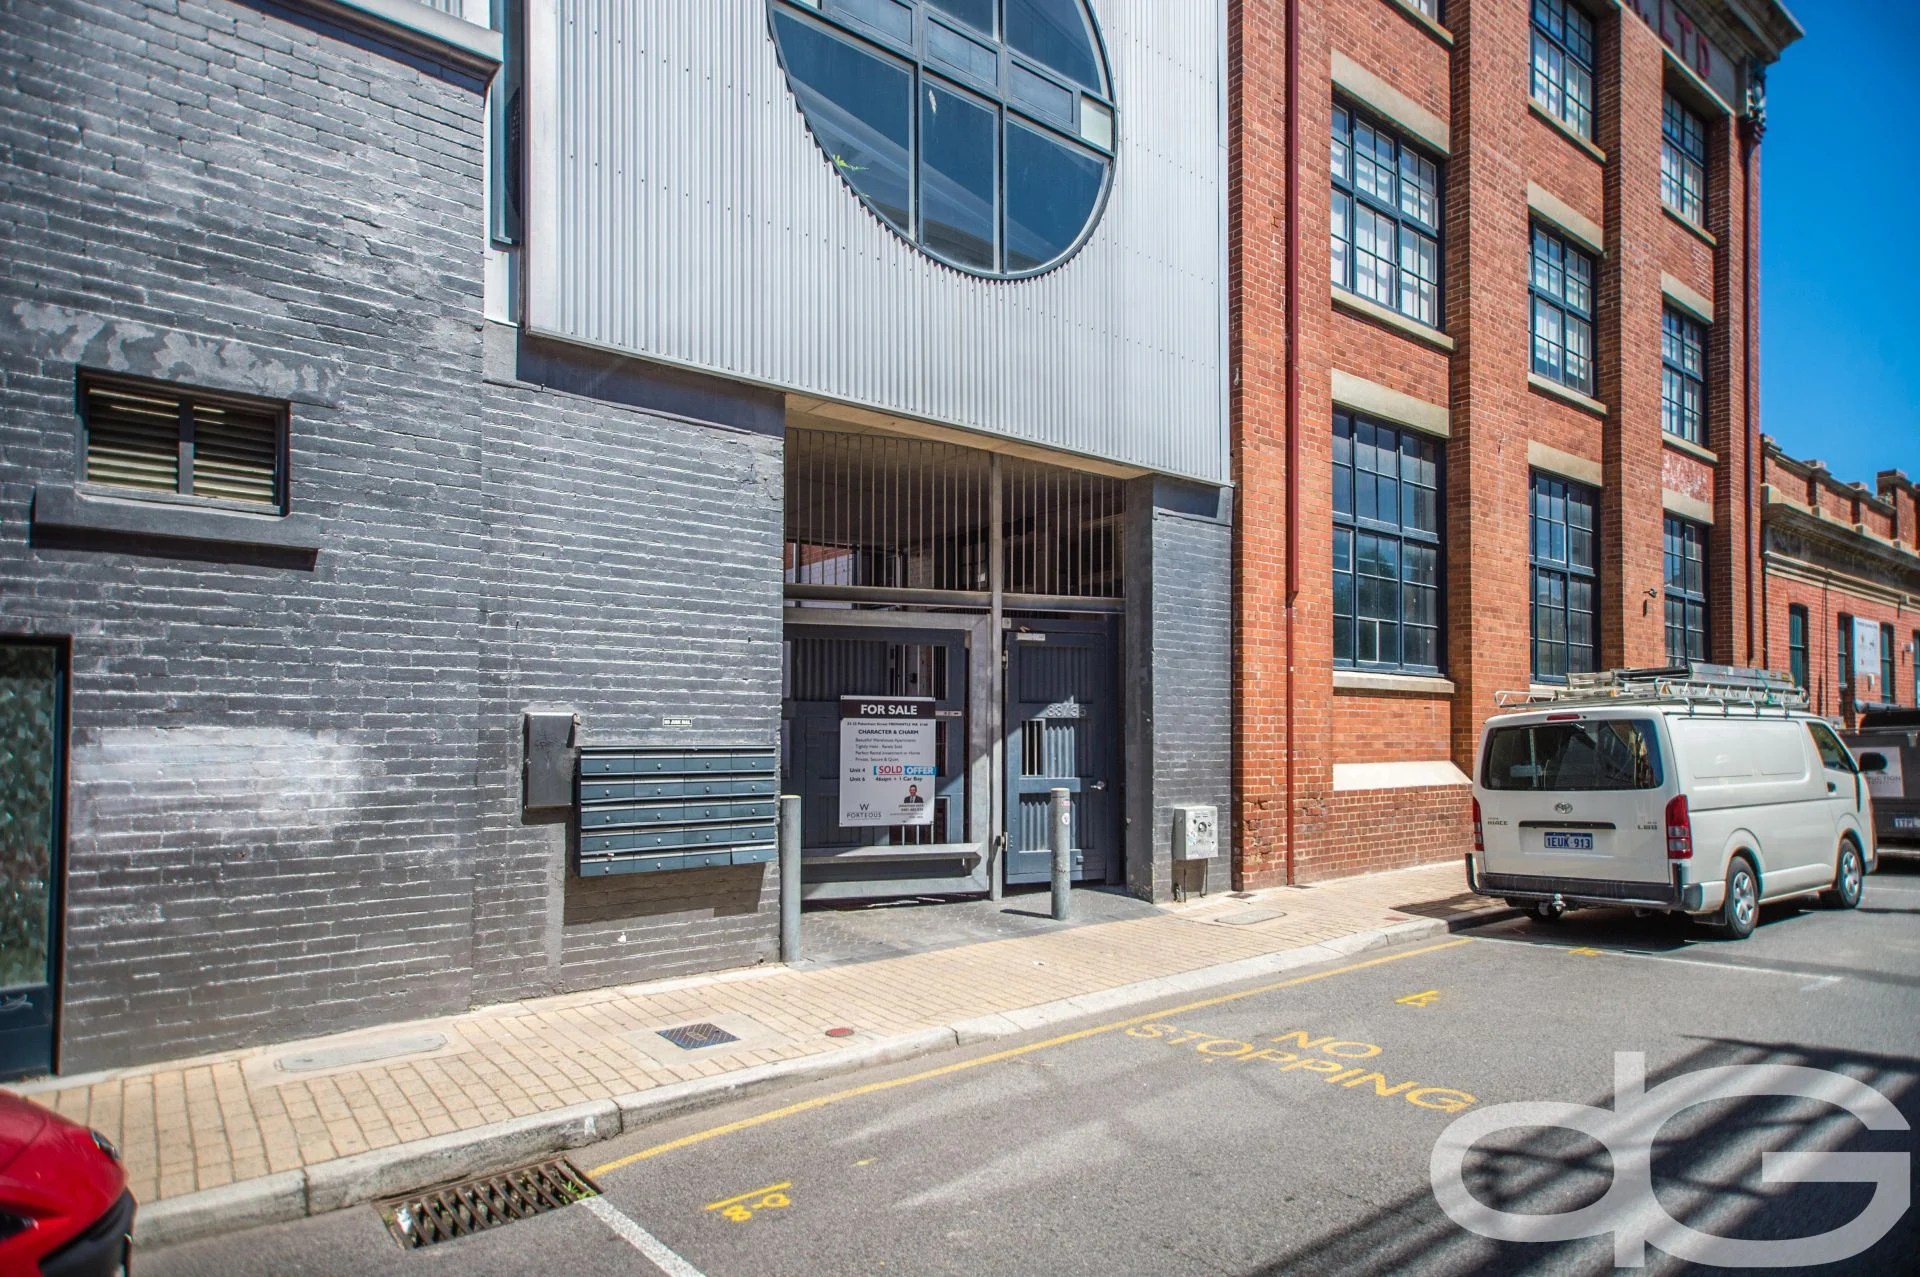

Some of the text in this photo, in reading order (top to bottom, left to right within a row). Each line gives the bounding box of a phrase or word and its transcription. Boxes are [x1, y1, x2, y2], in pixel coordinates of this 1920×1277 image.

[860, 704, 918, 715] FOR SALE
[879, 766, 903, 774] SOLD
[906, 766, 934, 774] OFFER
[1270, 1030, 1383, 1058] NO
[1125, 1023, 1478, 1113] STOPPING
